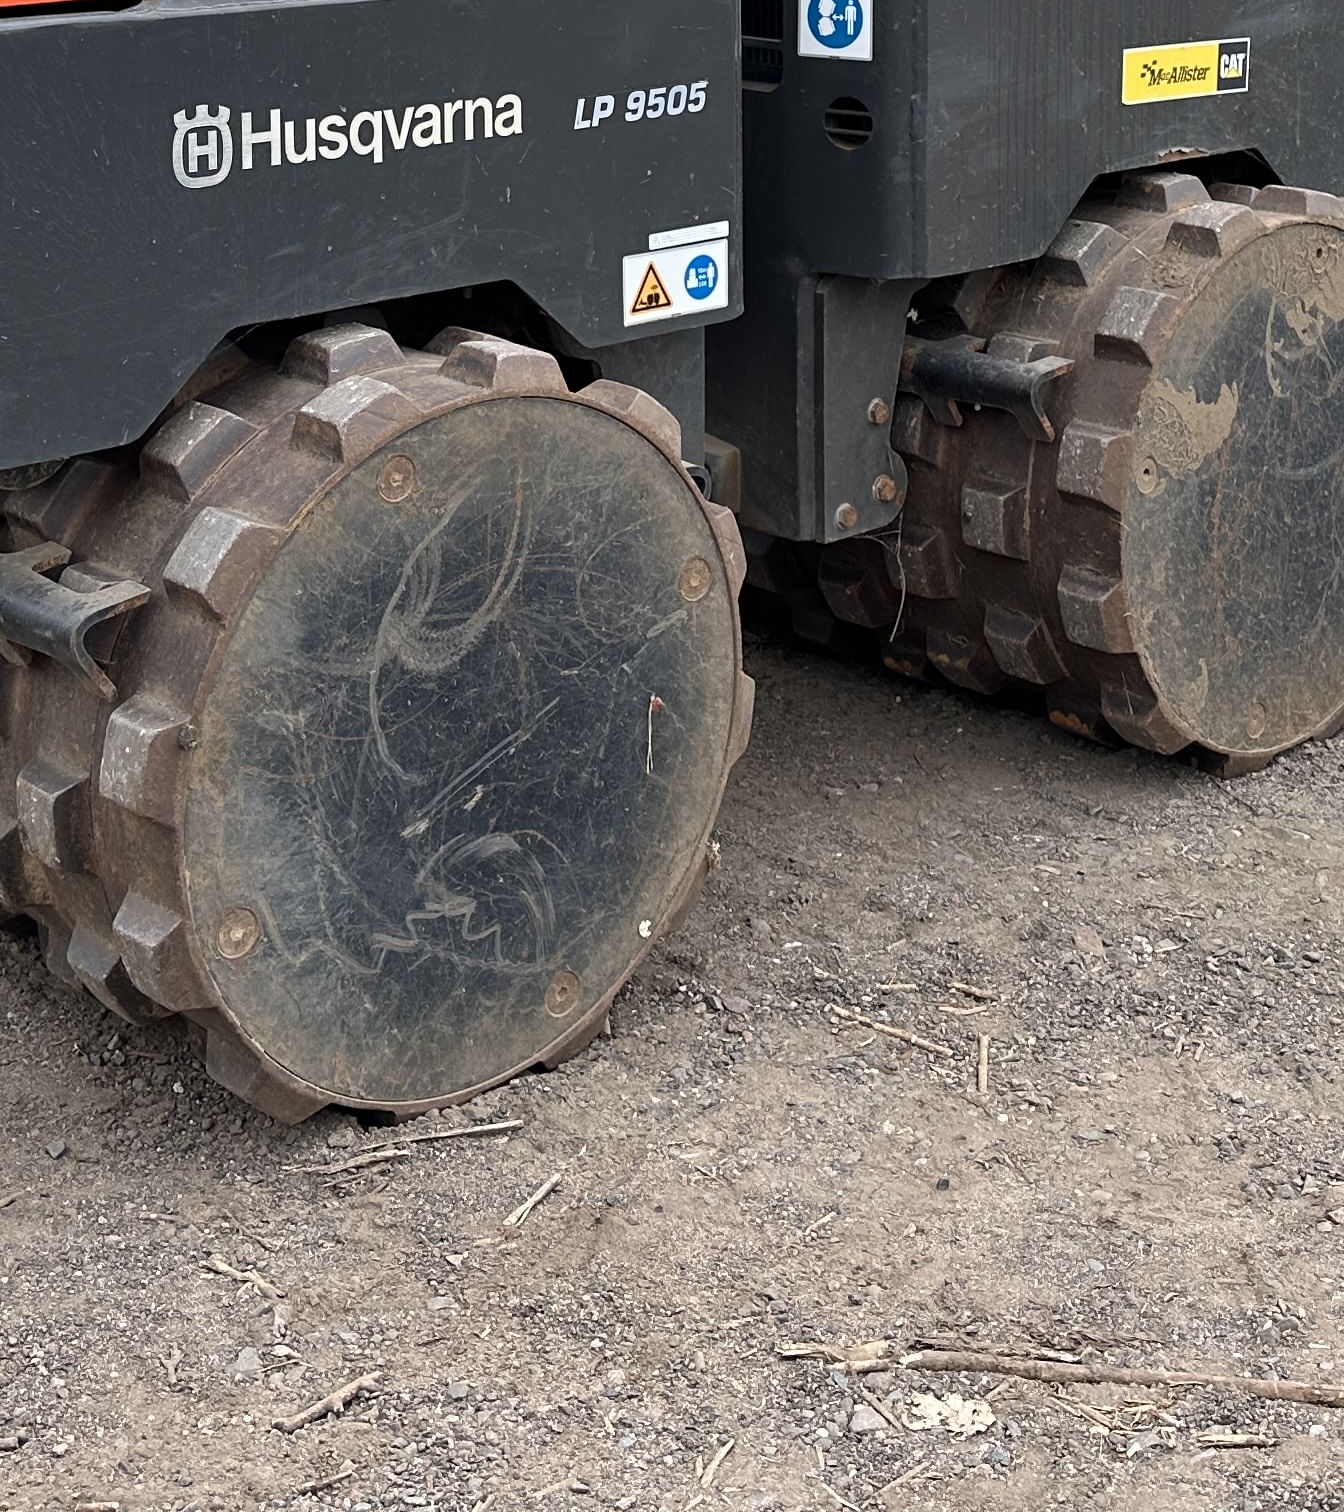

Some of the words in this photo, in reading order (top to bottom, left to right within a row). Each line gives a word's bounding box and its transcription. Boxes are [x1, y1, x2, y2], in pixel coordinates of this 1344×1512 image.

[1147, 64, 1211, 87] MacAllister
[1219, 53, 1246, 79] CAT
[573, 94, 615, 130] LP
[624, 81, 710, 123] 9505
[240, 93, 524, 170] Husqvarna
